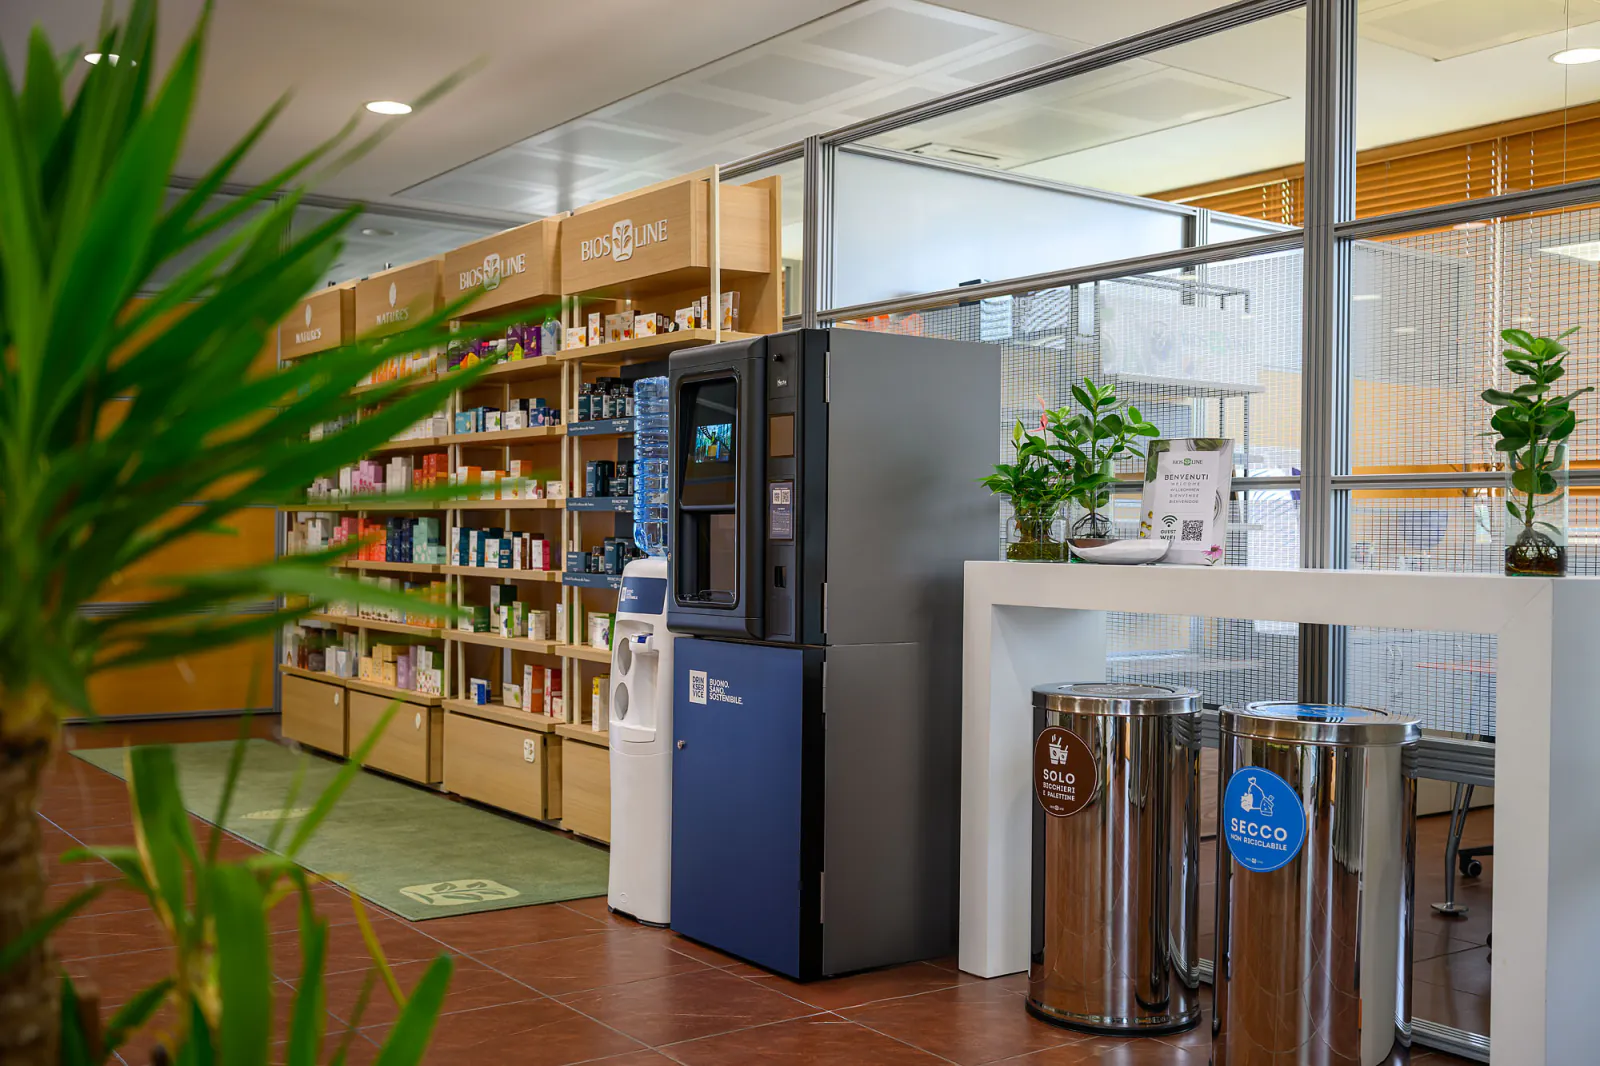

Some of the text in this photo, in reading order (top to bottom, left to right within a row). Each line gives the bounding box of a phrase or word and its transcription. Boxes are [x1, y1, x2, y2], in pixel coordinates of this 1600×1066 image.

[580, 218, 669, 262] BIOS LINE
[459, 253, 526, 291] BIOS LINE
[1164, 473, 1209, 481] BENVENUTI
[1043, 768, 1075, 784] SOLO
[1043, 782, 1075, 794] BICCHIERI
[1047, 791, 1075, 801] PALETTINE
[1231, 818, 1288, 842] SECCO
[1244, 837, 1287, 851] RICICLABILE
